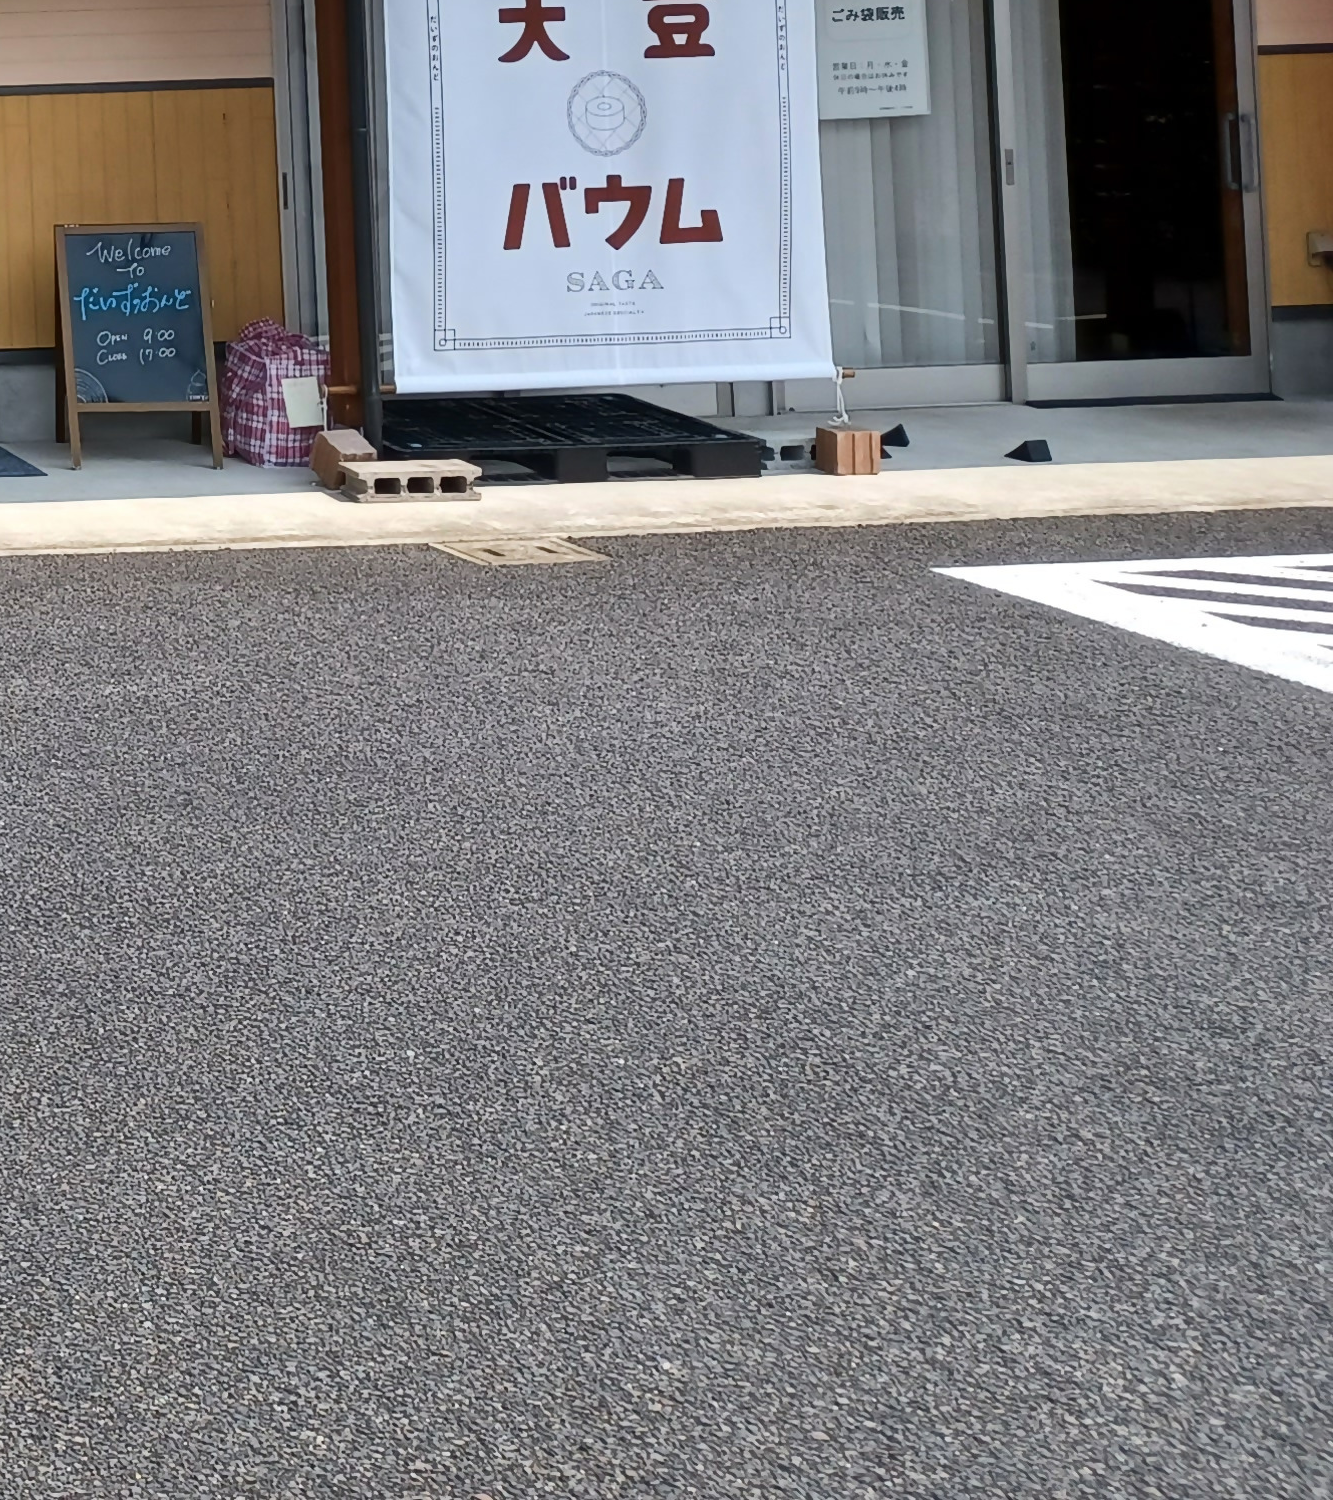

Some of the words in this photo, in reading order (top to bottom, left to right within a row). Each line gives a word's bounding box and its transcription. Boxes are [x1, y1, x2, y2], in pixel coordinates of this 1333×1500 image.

[831, 5, 906, 22] ごみ袋販売
[503, 174, 724, 251] バウム
[86, 238, 171, 263] Welcome
[566, 269, 664, 292] SAGA
